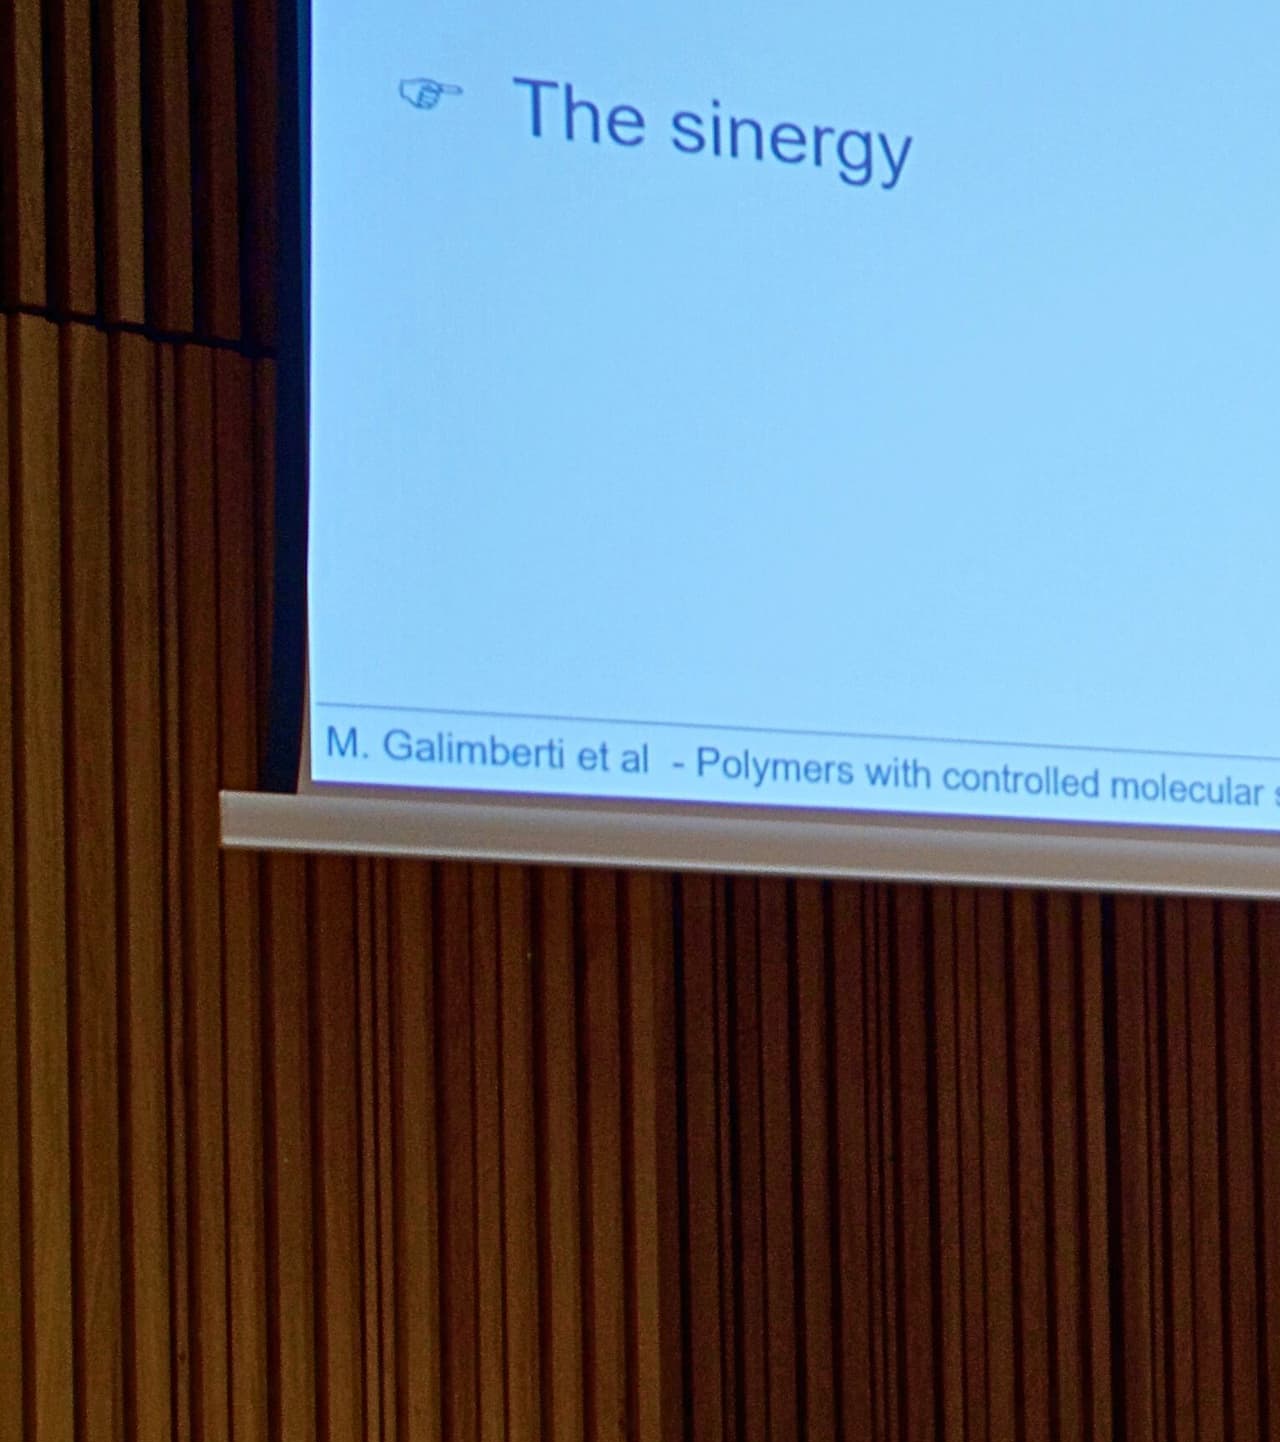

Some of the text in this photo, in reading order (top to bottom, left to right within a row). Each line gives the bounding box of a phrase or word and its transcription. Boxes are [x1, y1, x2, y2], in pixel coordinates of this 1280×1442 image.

[513, 76, 914, 190] The sinergy
[326, 725, 369, 759] M.
[384, 729, 565, 770] Galimberti
[577, 742, 611, 773] et
[621, 744, 650, 775] al
[697, 747, 855, 789] Polymers
[865, 757, 931, 790] with
[943, 764, 1100, 800] controlled
[1111, 773, 1265, 808] molecular
